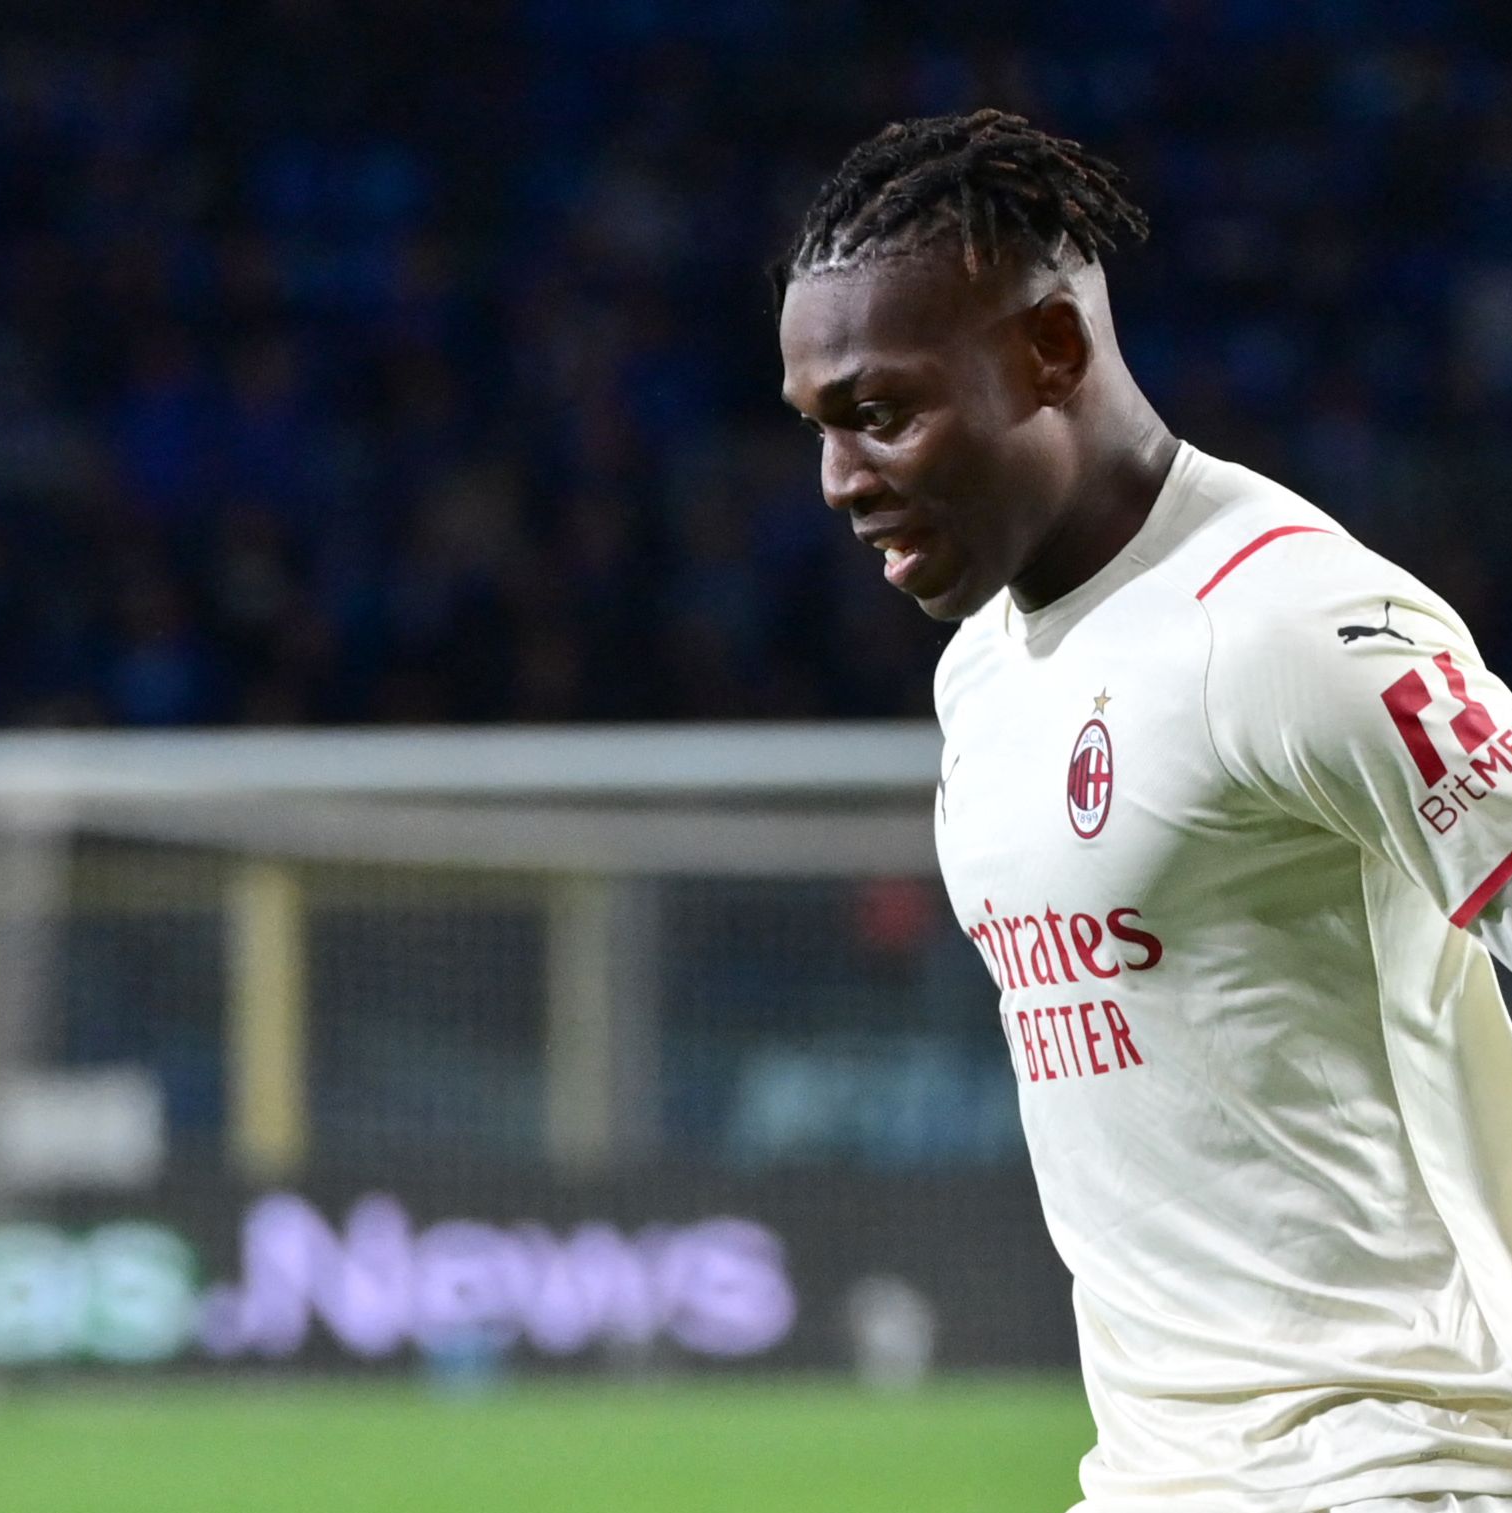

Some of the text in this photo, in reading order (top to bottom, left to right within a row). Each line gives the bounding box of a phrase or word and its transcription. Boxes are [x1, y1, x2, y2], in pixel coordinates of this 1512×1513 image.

[1082, 729, 1105, 748] ACM
[1076, 811, 1099, 824] 1899
[967, 897, 1163, 990] mirates
[1017, 999, 1143, 1082] BETTER
